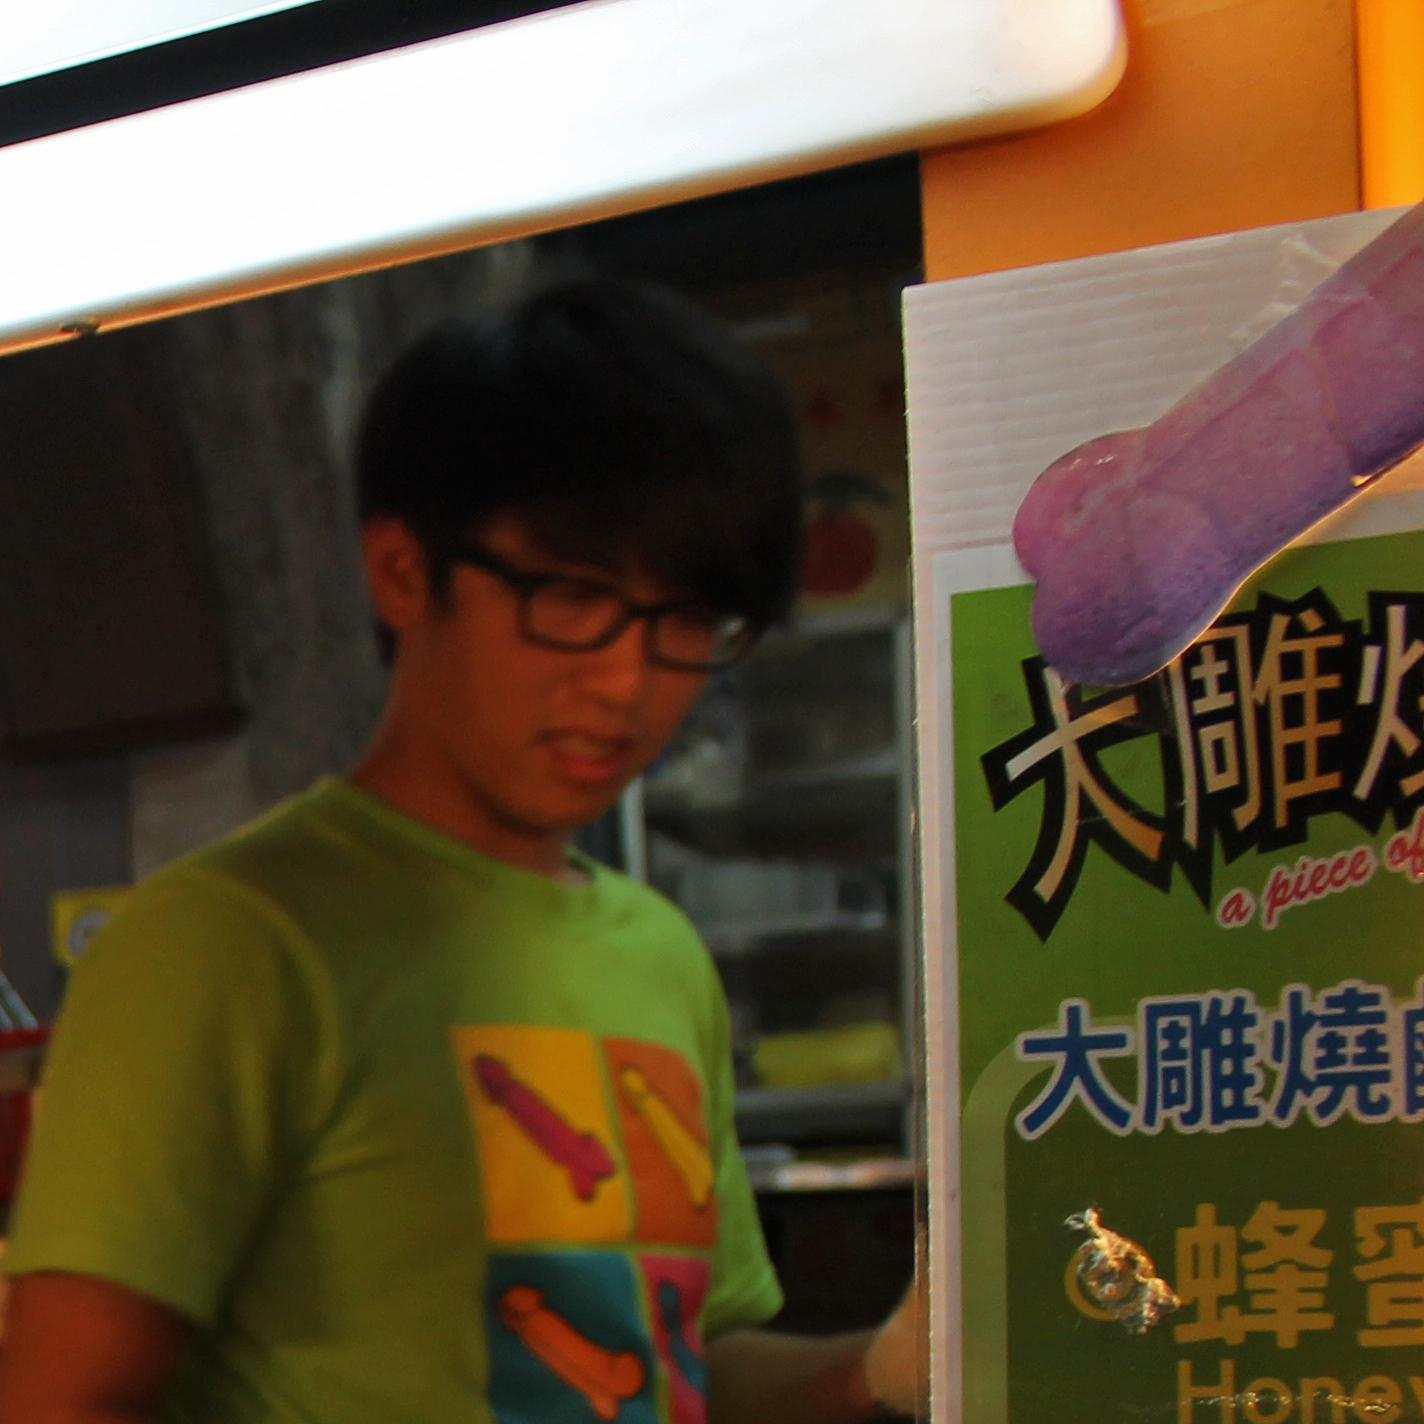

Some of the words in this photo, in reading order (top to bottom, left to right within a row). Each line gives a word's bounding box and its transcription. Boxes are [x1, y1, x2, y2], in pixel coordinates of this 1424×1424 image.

[1219, 888, 1256, 929] a
[1263, 845, 1378, 929] piece
[1016, 979, 1424, 1140] 大雕燒
